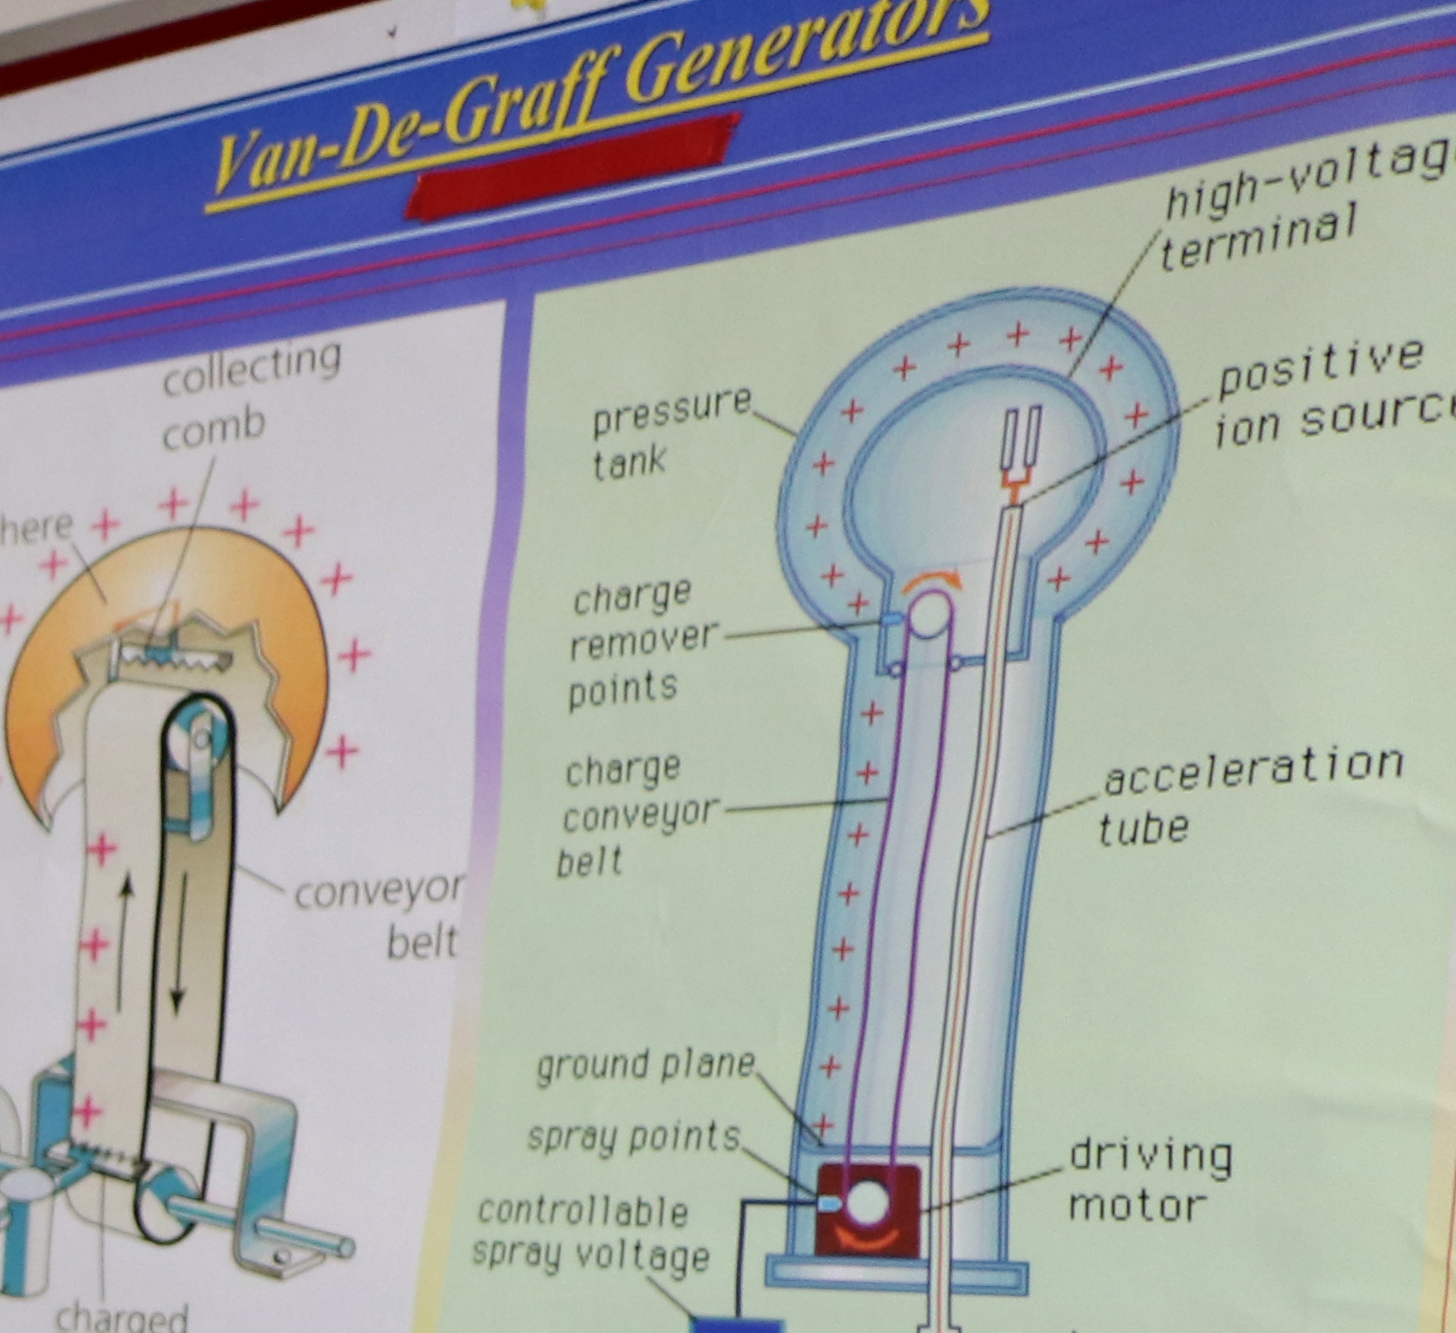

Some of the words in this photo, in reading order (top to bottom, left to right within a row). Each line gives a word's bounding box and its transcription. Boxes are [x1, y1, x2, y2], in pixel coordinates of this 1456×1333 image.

[215, 44, 622, 195] Van-De-Graff
[625, 0, 992, 104] Generators
[1167, 138, 1456, 221] high-voltag
[1162, 201, 1357, 272] terminal
[162, 341, 343, 398] collecting
[1219, 339, 1424, 402] positive
[162, 405, 267, 451] comb
[593, 387, 752, 440] pressure
[1217, 412, 1280, 449] ion
[1301, 392, 1456, 437] sourc
[593, 444, 667, 482] tank
[574, 579, 691, 617] charge
[570, 622, 720, 661] remover
[570, 672, 678, 714] points
[566, 754, 681, 791] charge
[1104, 745, 1405, 797] acceleration
[563, 798, 721, 834] conveyor
[1100, 812, 1190, 846] tube
[558, 846, 624, 879] belt
[294, 873, 466, 910] conveyor
[387, 924, 457, 959] belt
[537, 1048, 649, 1088] ground
[661, 1048, 756, 1084] plane
[528, 1124, 617, 1159] spray
[630, 1120, 742, 1153] points
[1071, 1136, 1234, 1181] driving
[478, 1195, 689, 1228] controllable
[1070, 1192, 1208, 1222] motor
[473, 1237, 561, 1277] spray
[577, 1239, 710, 1280] voltage
